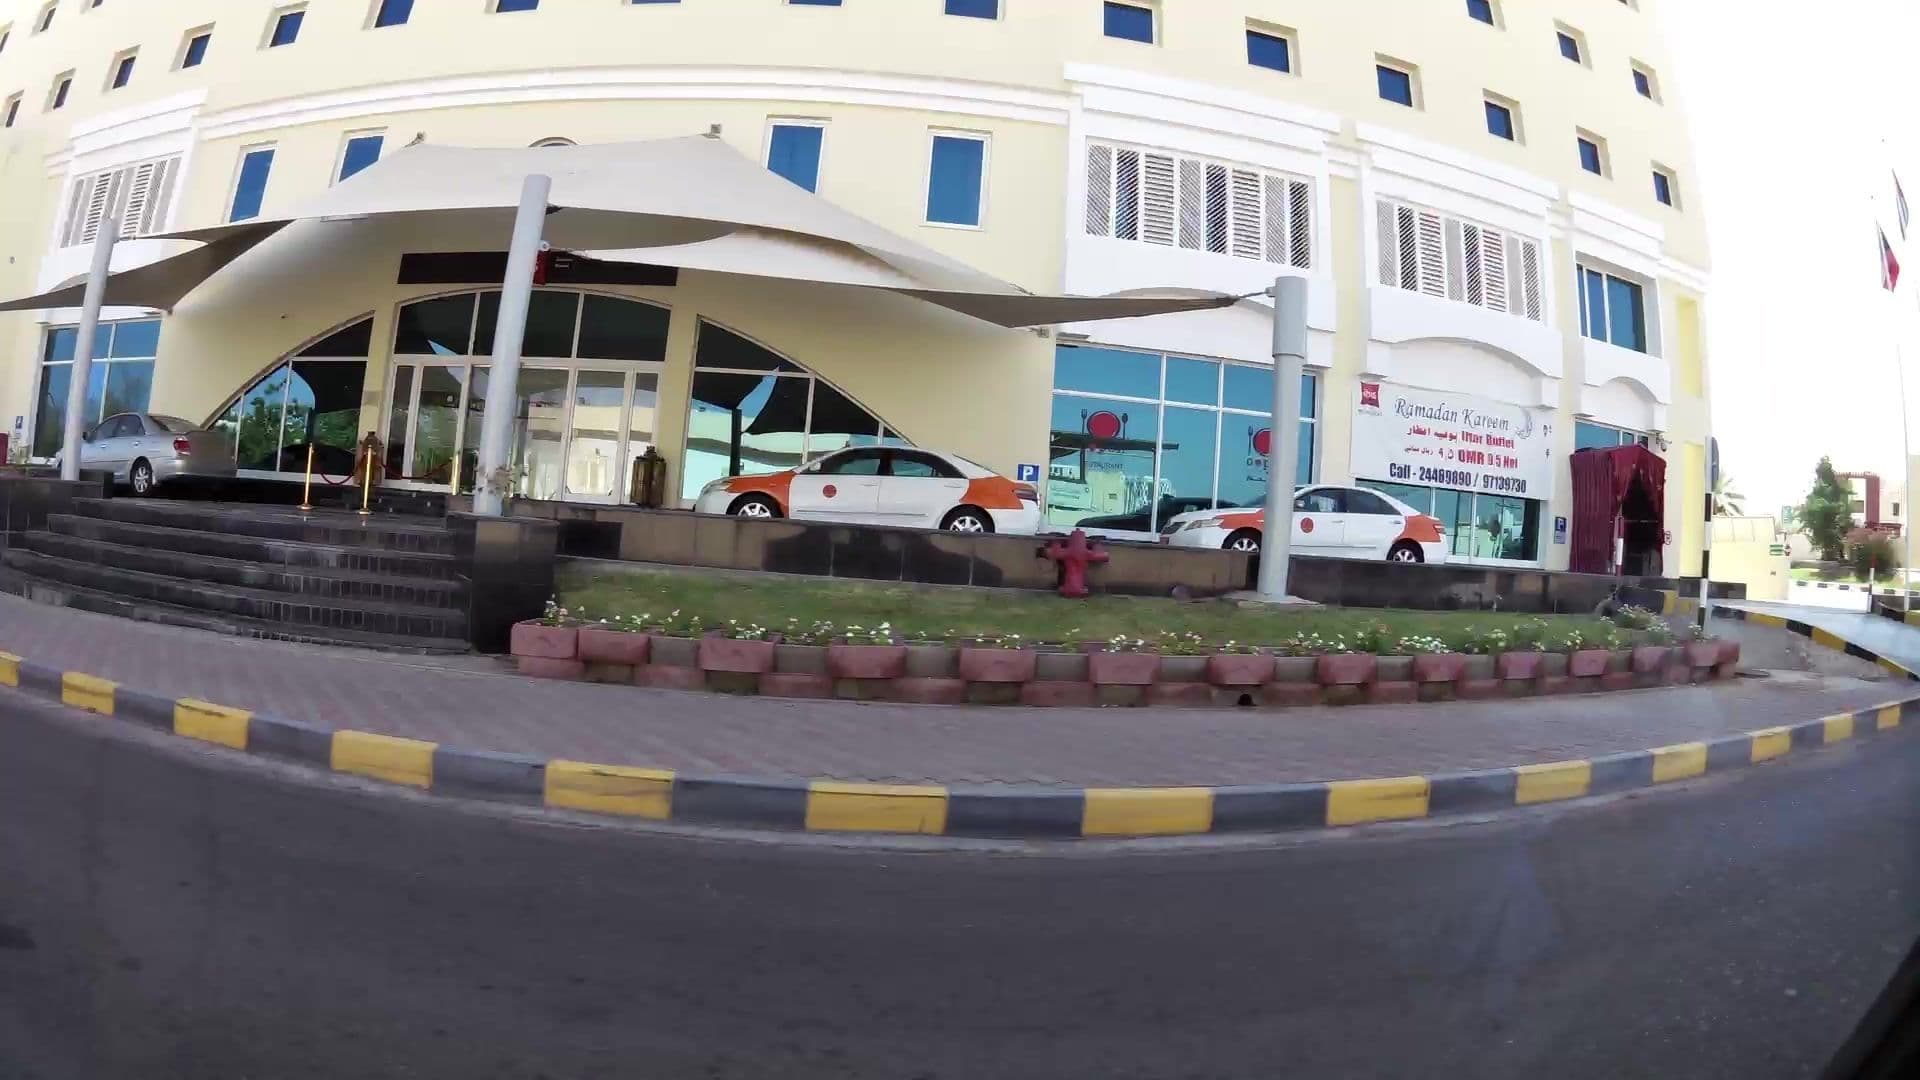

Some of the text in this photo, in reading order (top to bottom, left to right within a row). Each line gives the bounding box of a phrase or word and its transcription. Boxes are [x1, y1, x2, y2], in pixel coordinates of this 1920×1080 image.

[1394, 397, 1509, 431] Ramadan Kareem
[1461, 430, 1515, 450] Iftar Buffet
[1457, 449, 1485, 466] OMR
[1023, 465, 1034, 480] P
[1389, 462, 1411, 480] Call
